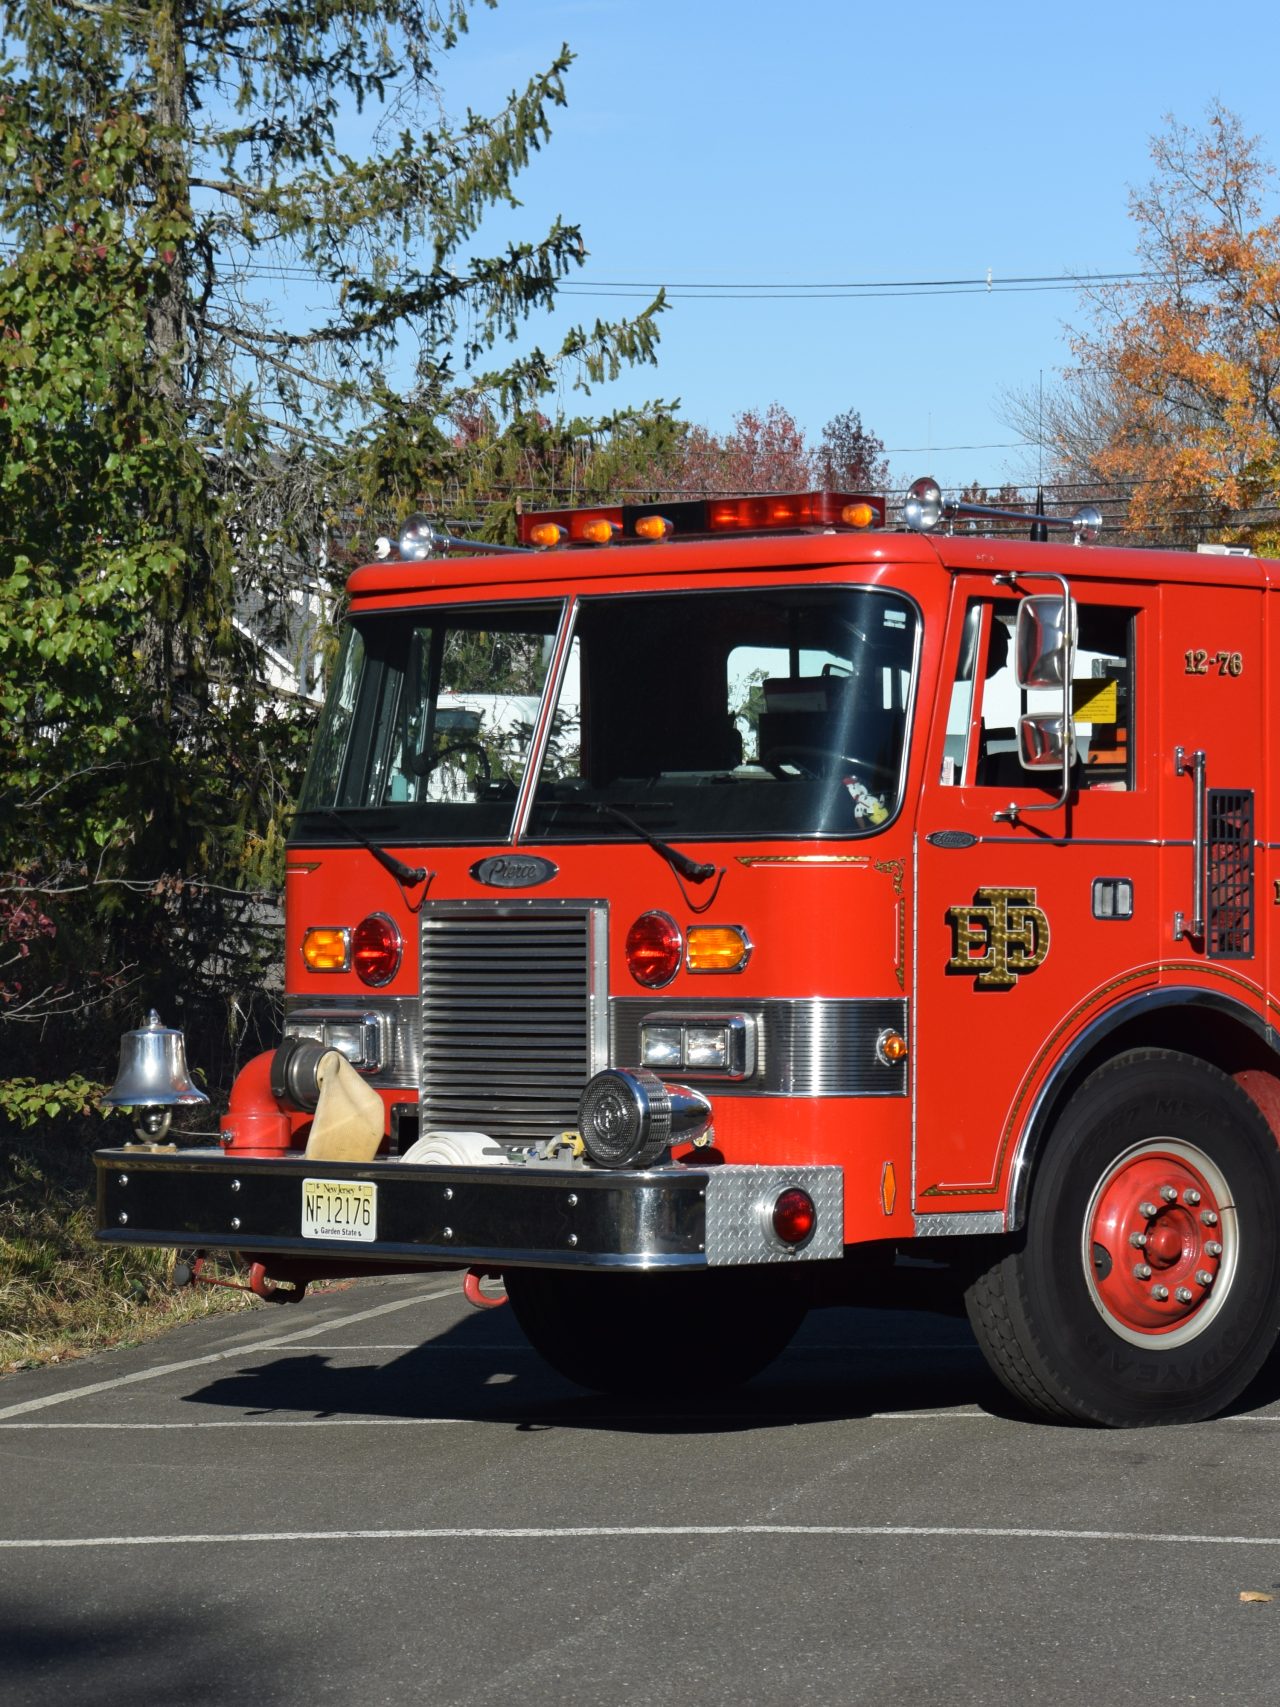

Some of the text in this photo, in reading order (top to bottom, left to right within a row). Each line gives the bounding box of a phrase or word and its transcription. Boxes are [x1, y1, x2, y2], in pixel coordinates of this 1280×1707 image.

[1185, 649, 1243, 677] 12-76
[488, 859, 537, 881] Pierce
[323, 1183, 356, 1196] New Jersey
[306, 1194, 371, 1226] NF12176
[320, 1226, 357, 1236] Garden State
